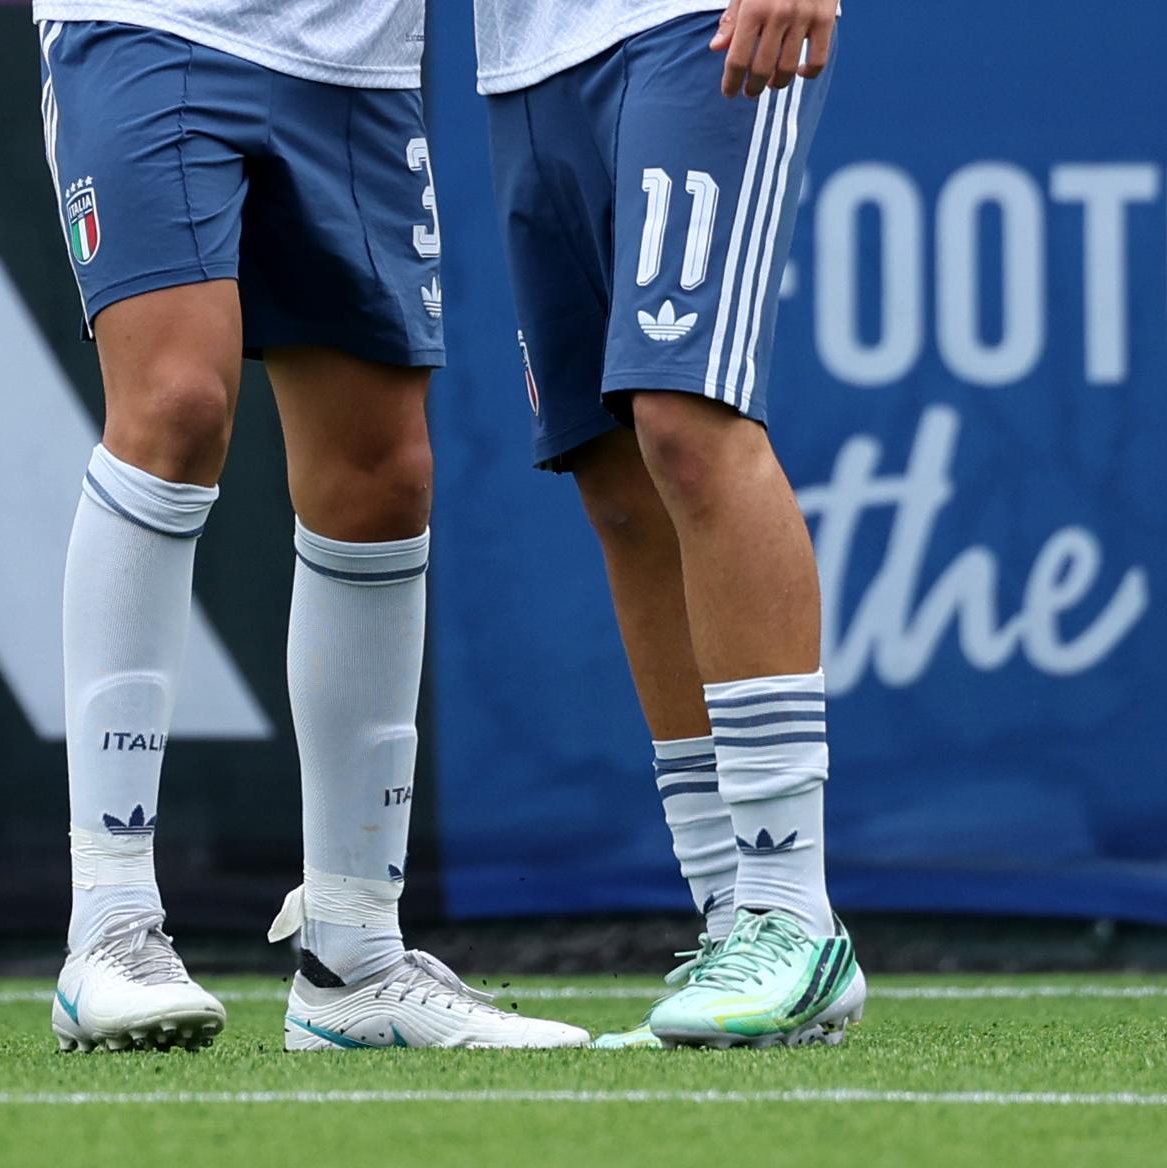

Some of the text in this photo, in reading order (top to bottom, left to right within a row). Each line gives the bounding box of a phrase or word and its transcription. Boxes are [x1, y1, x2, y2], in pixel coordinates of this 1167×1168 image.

[69, 194, 92, 219] ITALIA
[406, 137, 441, 258] 3
[636, 168, 719, 290] 11
[796, 404, 1149, 697] the
[103, 732, 167, 752] ITALI
